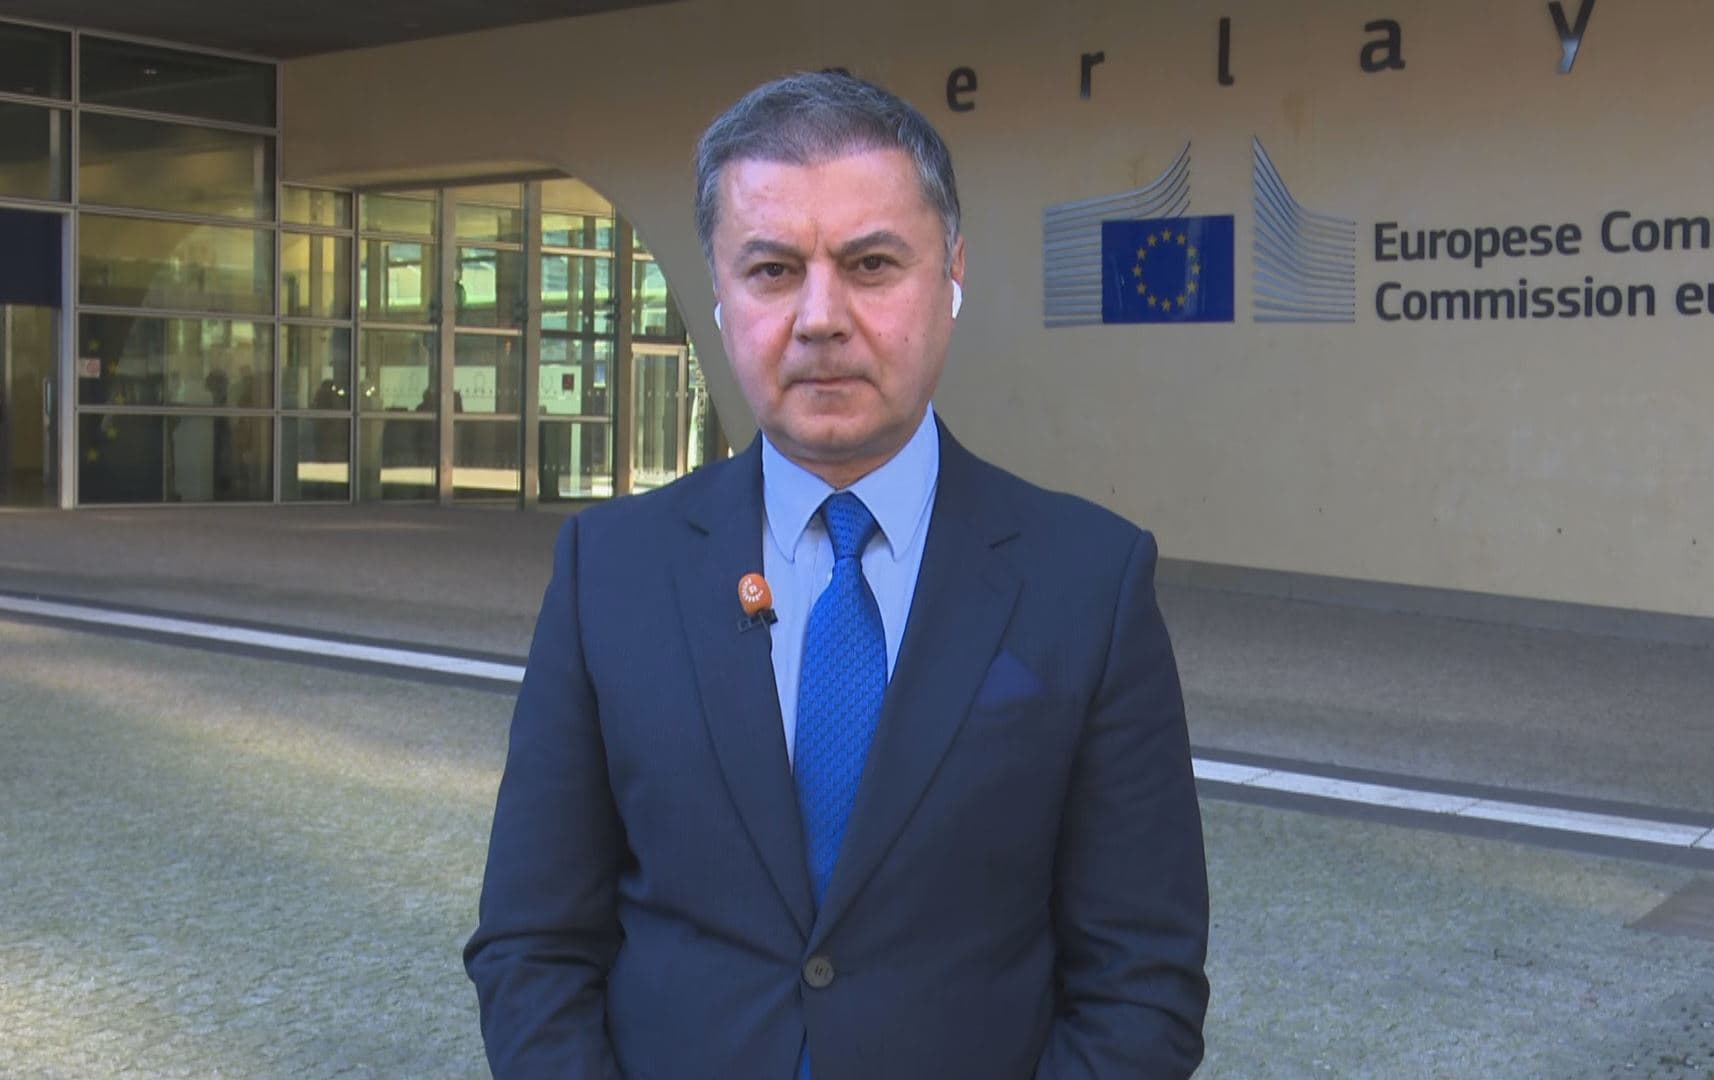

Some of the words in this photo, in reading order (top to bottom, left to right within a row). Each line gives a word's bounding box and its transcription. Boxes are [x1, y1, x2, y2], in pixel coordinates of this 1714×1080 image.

[820, 0, 1595, 113] erlay
[1374, 221, 1582, 268] Europese
[1375, 275, 1656, 321] Commission
